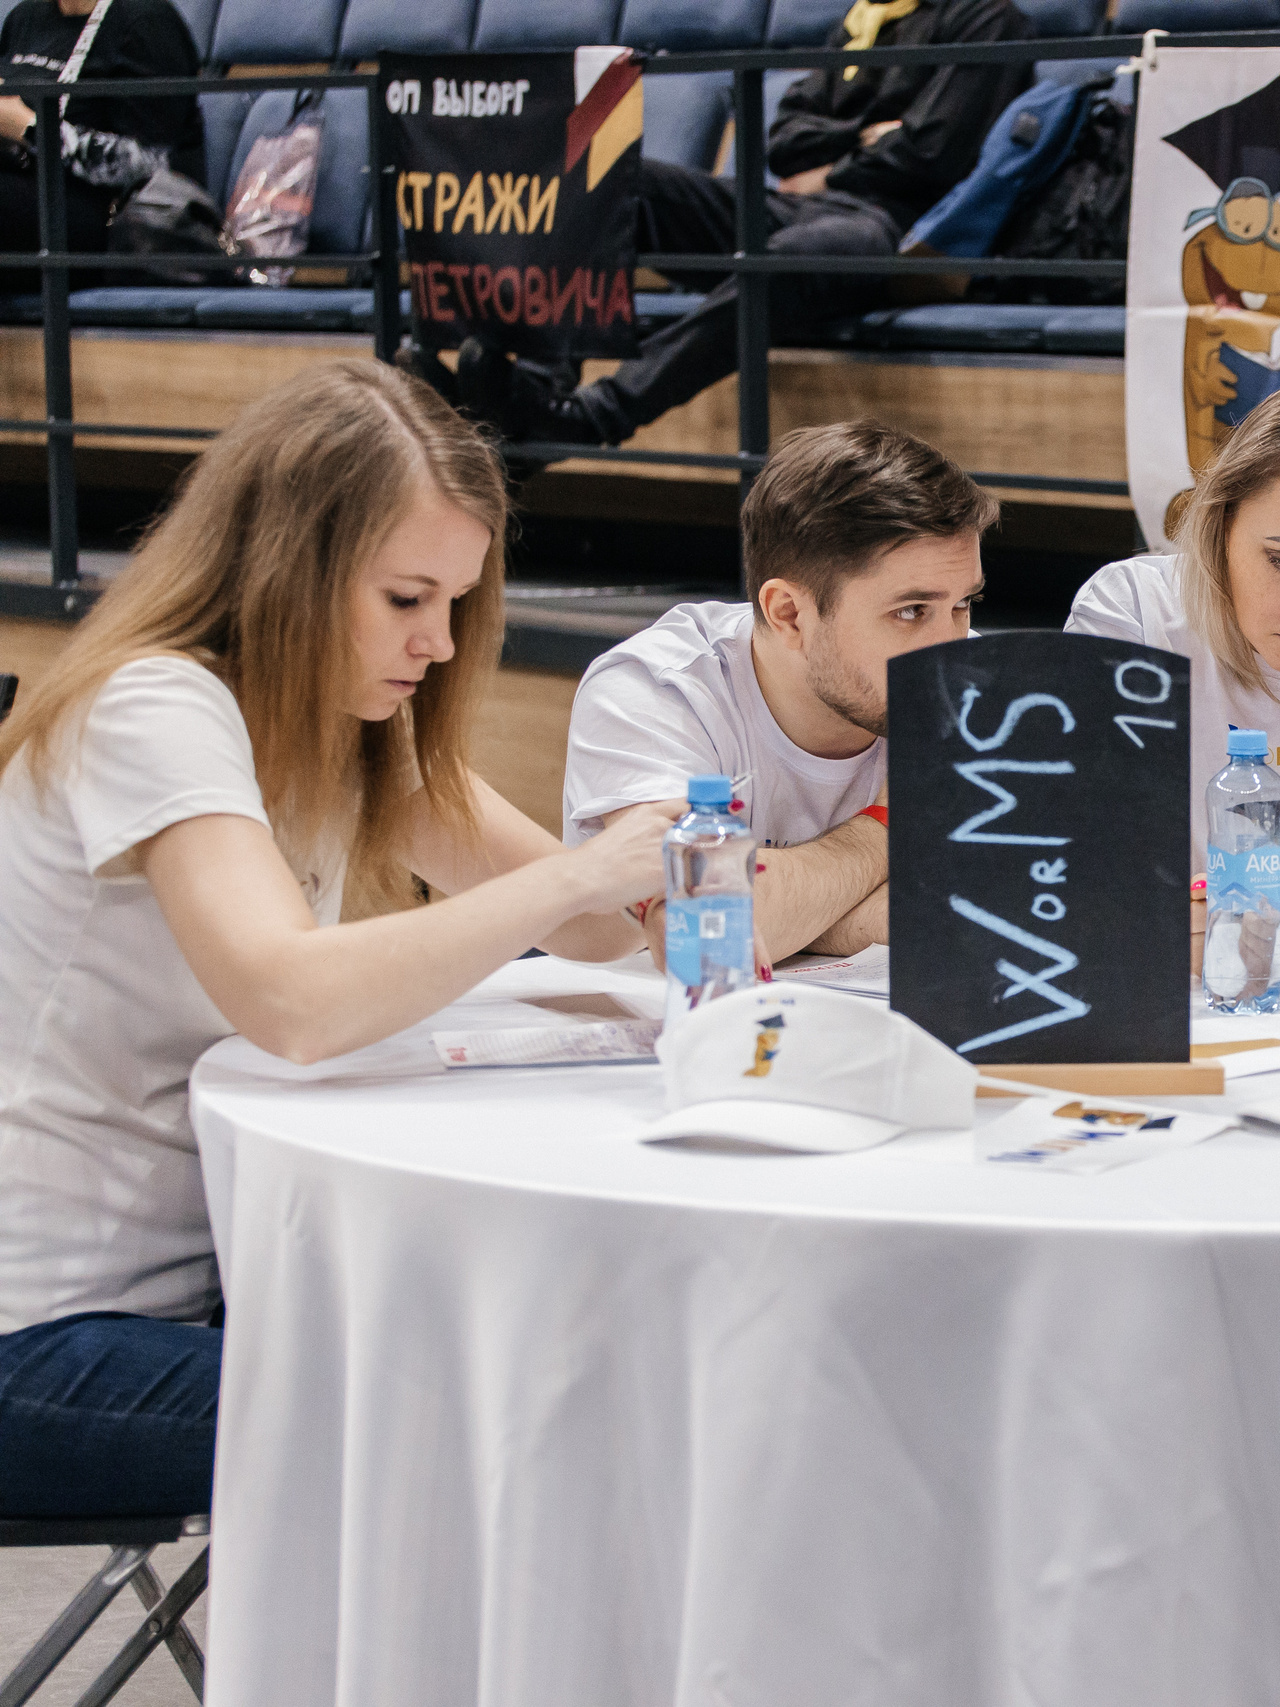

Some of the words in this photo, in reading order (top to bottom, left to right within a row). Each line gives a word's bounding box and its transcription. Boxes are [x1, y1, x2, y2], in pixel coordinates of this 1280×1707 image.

[385, 79, 421, 115] ОП
[432, 77, 530, 118] ВЫБОРГ
[1114, 659, 1177, 748] 10
